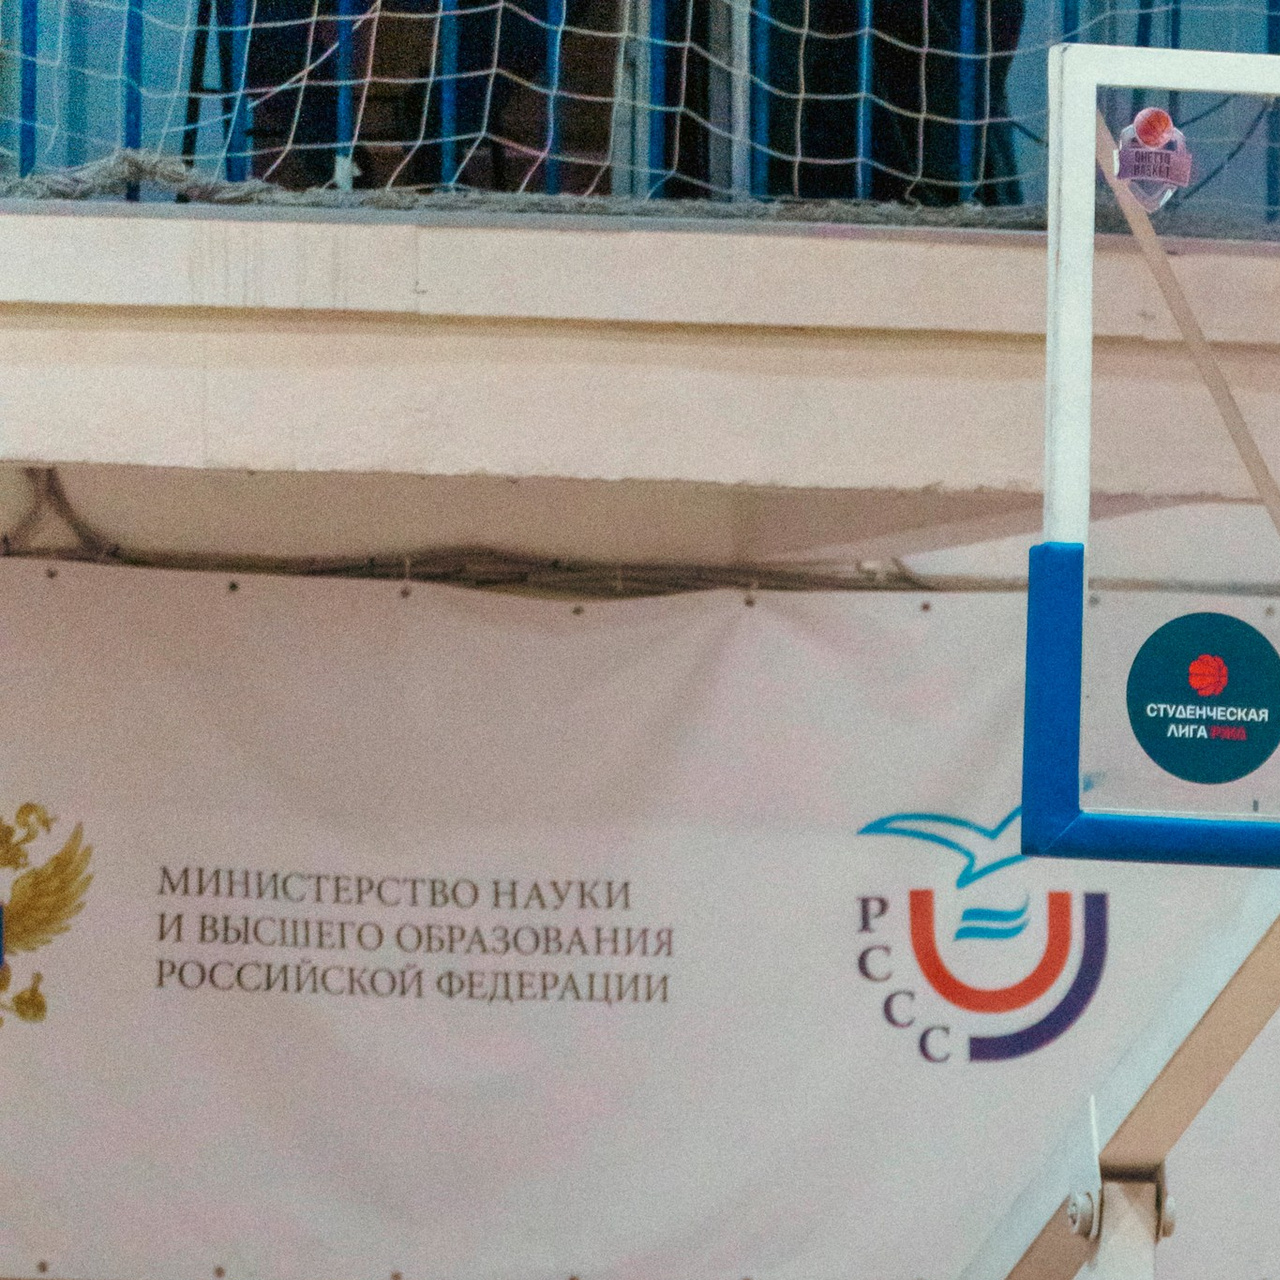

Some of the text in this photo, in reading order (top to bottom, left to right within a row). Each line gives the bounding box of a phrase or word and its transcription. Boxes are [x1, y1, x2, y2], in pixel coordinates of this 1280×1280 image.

[1146, 703, 1269, 722] СТУДЕНЧЕСКАЯ
[1167, 723, 1208, 739] ЛИГА
[158, 866, 632, 912] МИНИСТЕРСТВО НАУКИ
[157, 912, 675, 959] И ВЫСШЕГО ОБРАЗОВАНИЯ
[155, 957, 669, 1006] РОССИЙСКОЙ ФЕДЕРАЦИИ
